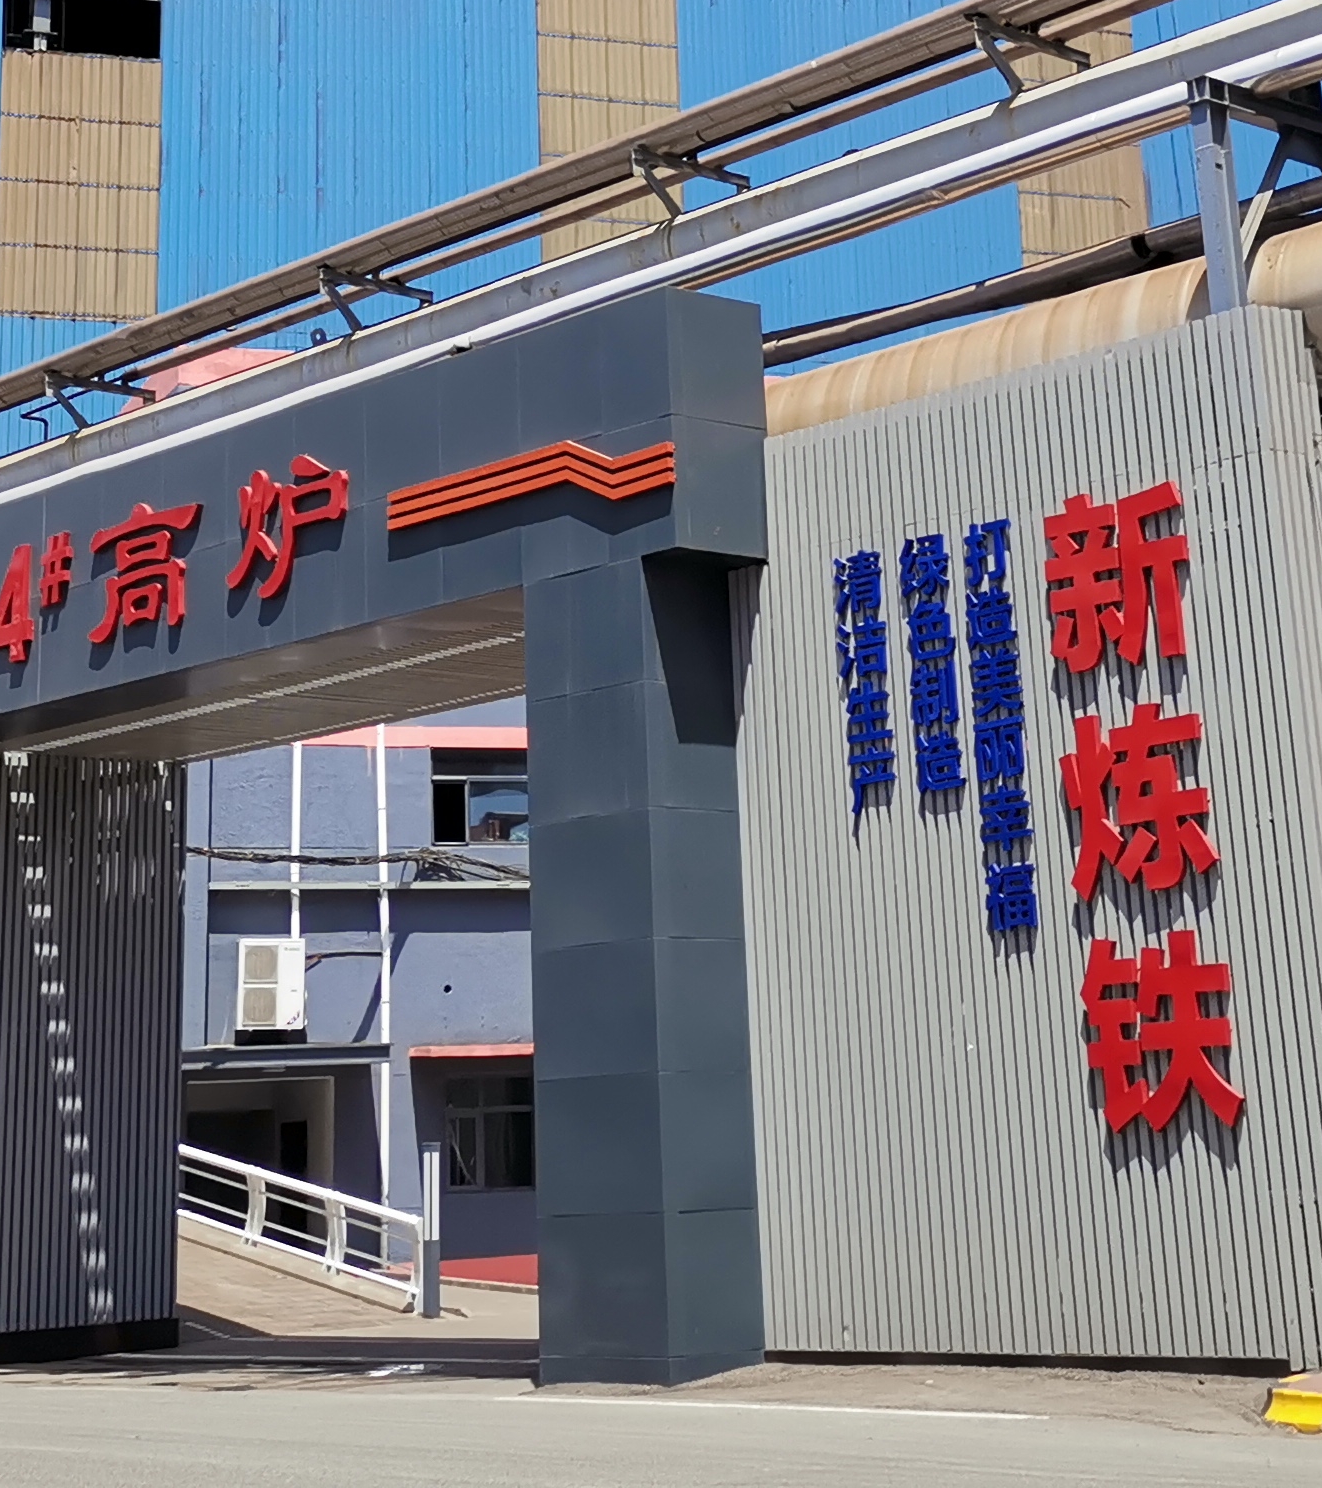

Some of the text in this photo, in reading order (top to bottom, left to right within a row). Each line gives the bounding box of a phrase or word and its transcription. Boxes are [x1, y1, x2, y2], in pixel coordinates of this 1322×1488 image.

[834, 549, 896, 815] 清洁生产
[899, 533, 965, 793] 绿色制造
[963, 518, 1038, 931] 打造美丽幸福
[1043, 480, 1244, 1134] 新炼铁
